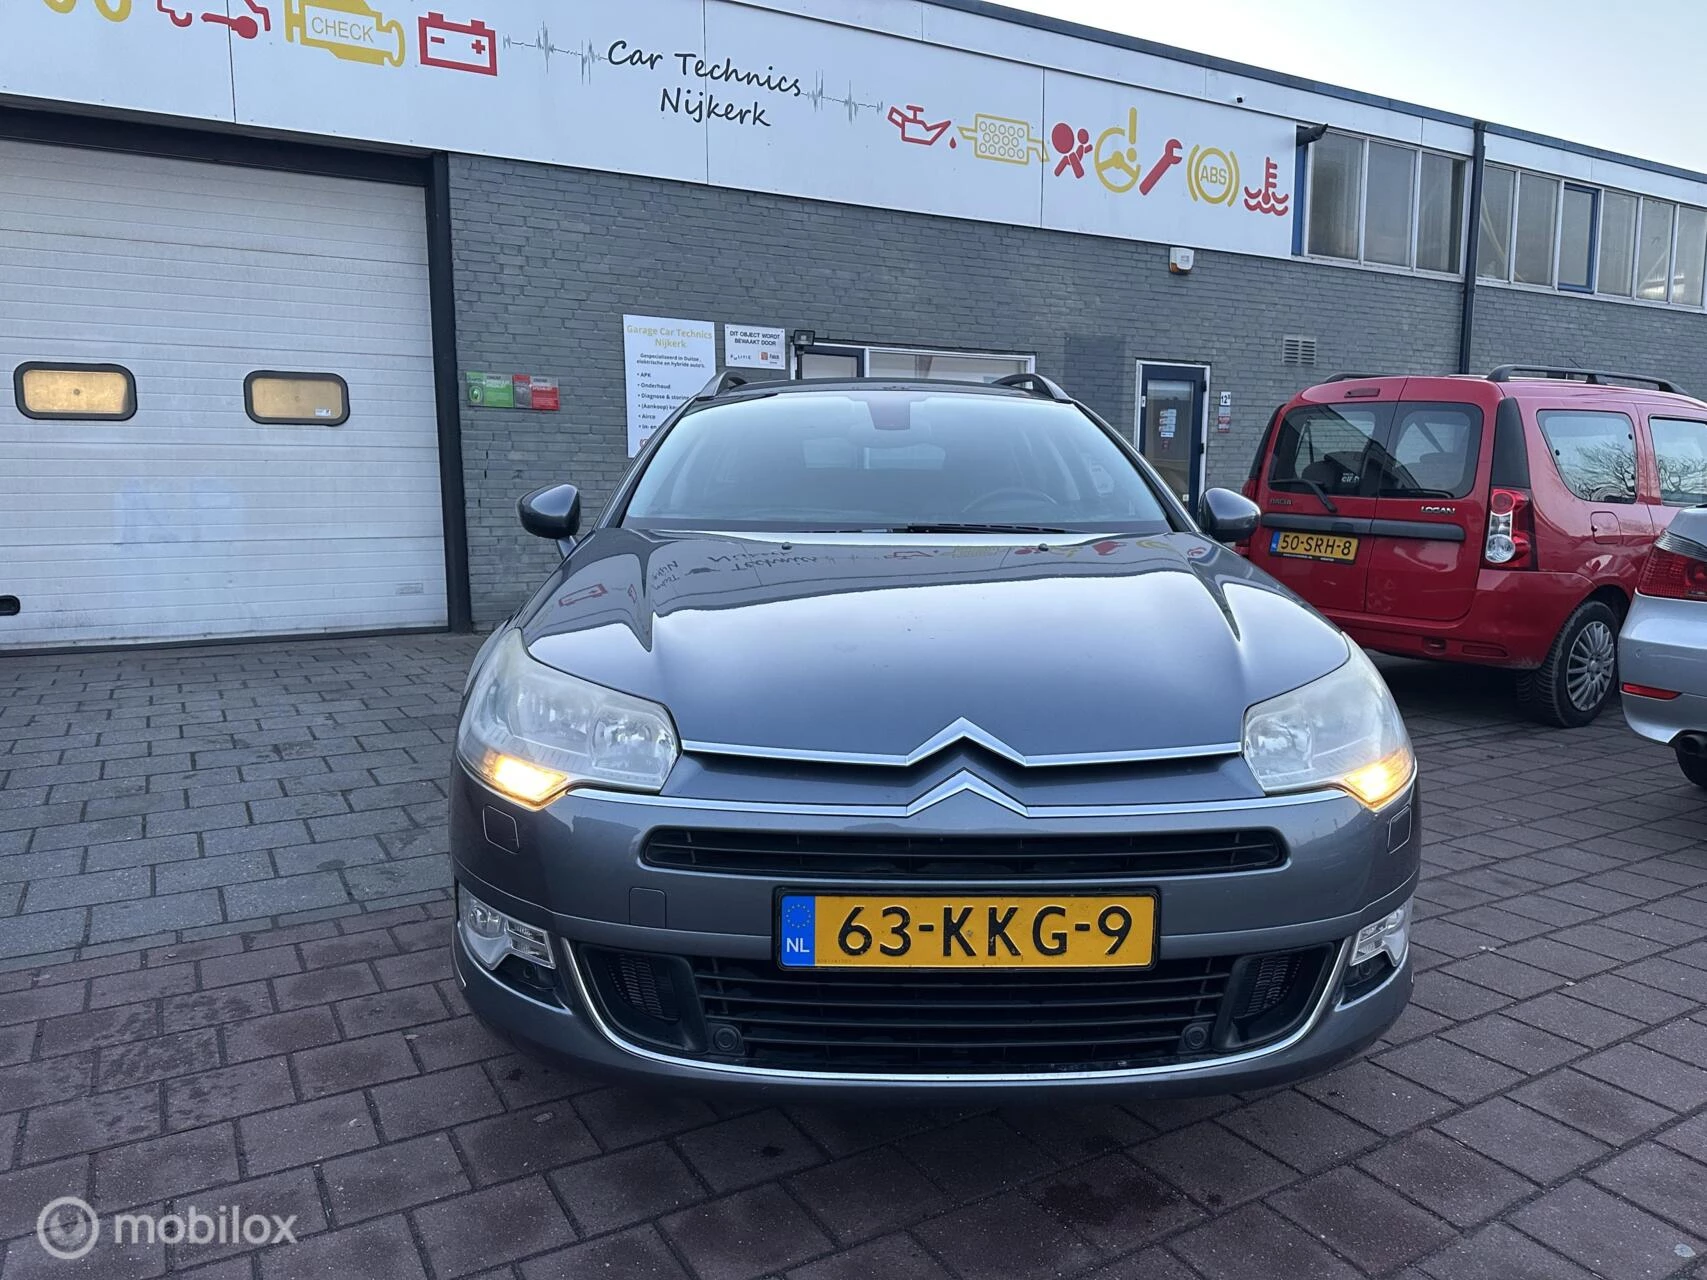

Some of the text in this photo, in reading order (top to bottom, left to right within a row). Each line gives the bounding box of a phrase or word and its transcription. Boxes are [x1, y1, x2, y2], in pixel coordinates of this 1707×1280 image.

[311, 16, 374, 43] CHECK
[607, 40, 801, 97] Car Technics
[660, 87, 771, 127] Nijkerk
[1200, 165, 1227, 185] ABS
[626, 325, 713, 340] Garage Car Technics
[655, 339, 687, 348] Nijkerk
[640, 353, 677, 361] Gespecialiseerd
[1420, 505, 1456, 515] LOGAN
[1280, 534, 1352, 557] 50-SRH-8
[836, 904, 1133, 957] 63-KKG-9
[785, 936, 810, 953] NL
